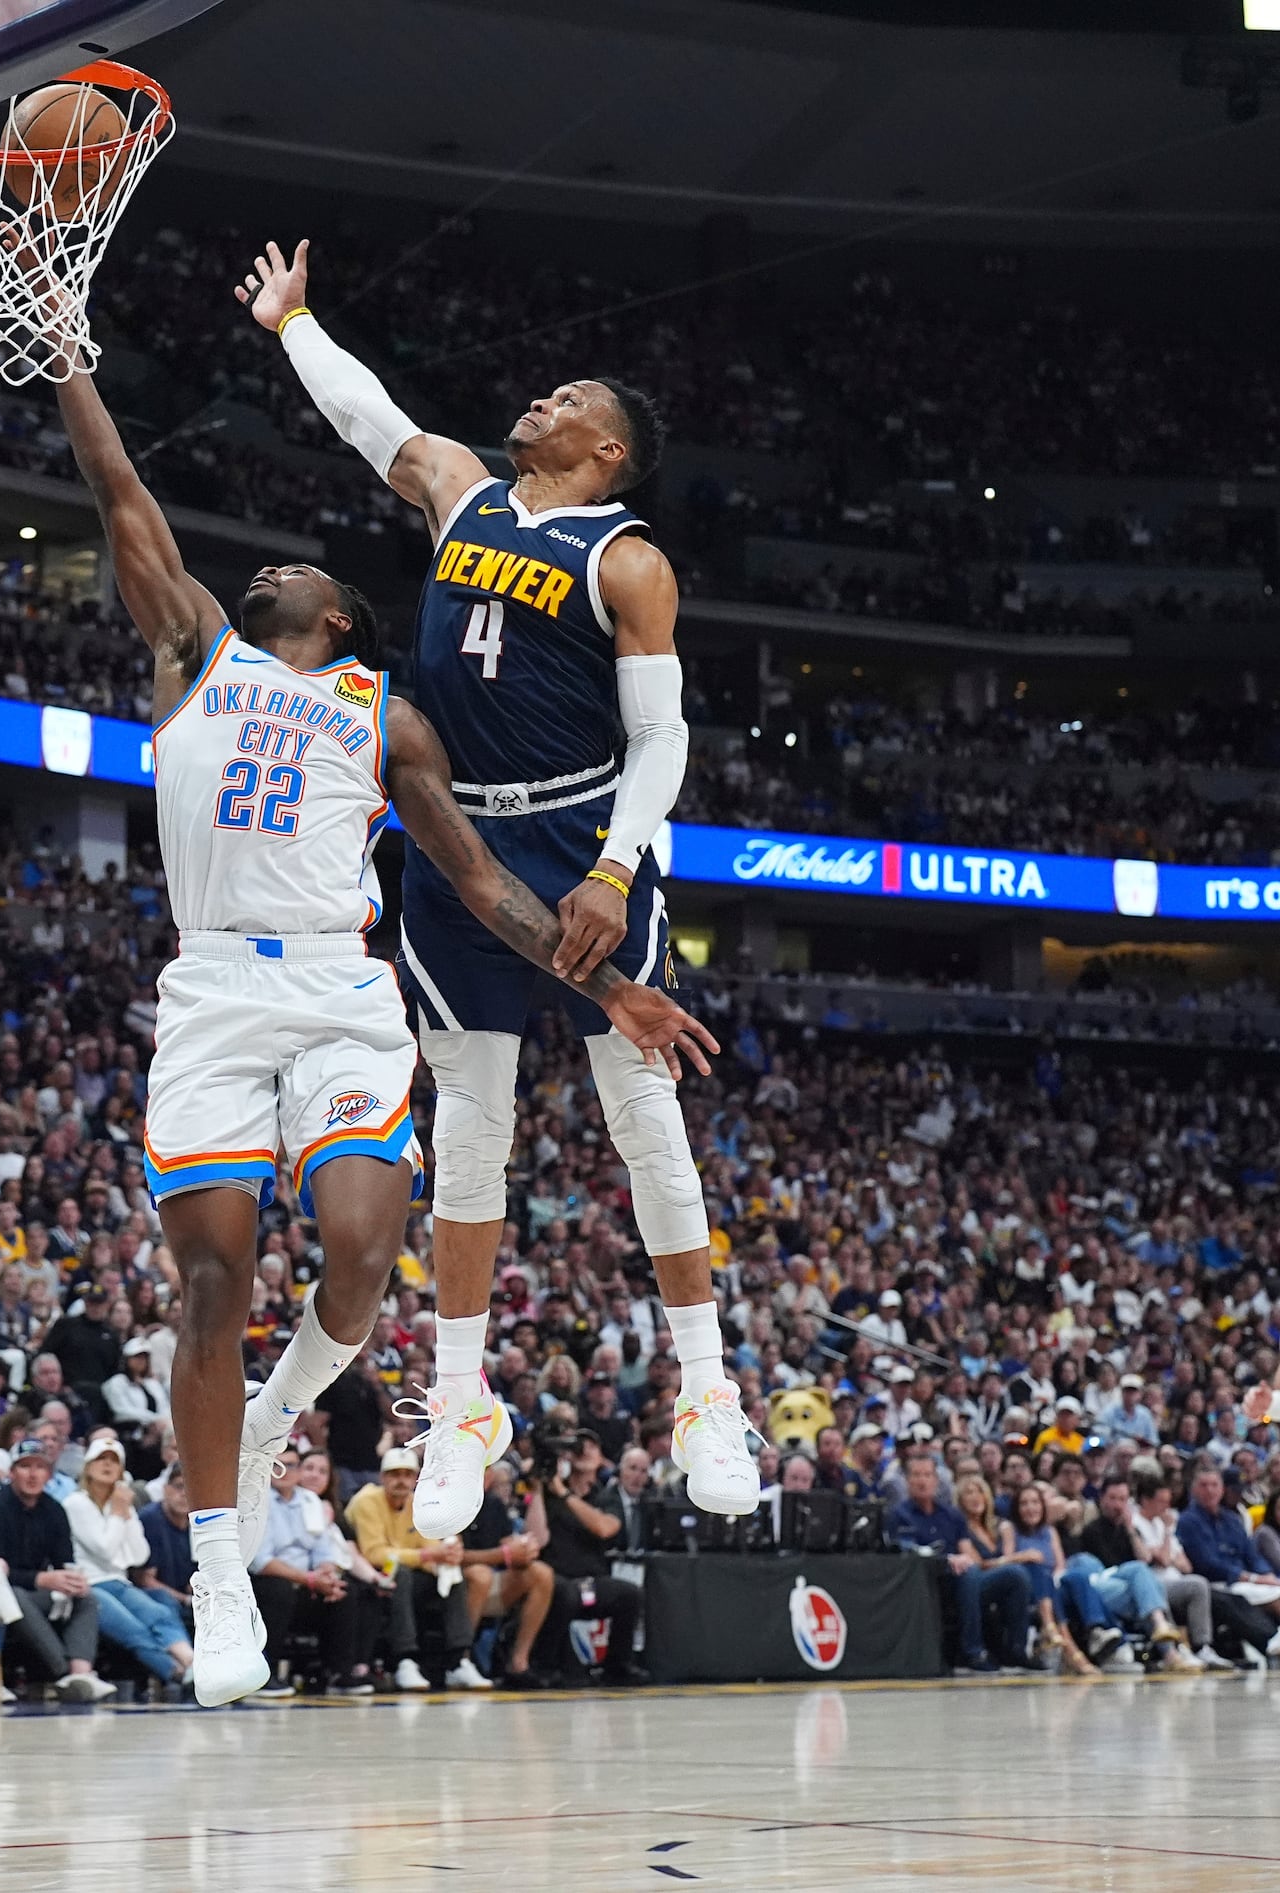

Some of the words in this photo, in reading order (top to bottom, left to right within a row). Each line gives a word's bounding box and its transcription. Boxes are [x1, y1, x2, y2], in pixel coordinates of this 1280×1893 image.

[546, 527, 587, 550] ibotta
[435, 540, 575, 619] DENVER
[460, 600, 504, 680] 4
[203, 682, 372, 757] OKLAHOMA
[237, 718, 314, 763] CITY
[214, 757, 306, 837] 22
[732, 839, 877, 886] Michelob
[910, 851, 1046, 900] ULTRA
[1205, 877, 1260, 910] IT'S
[332, 1096, 368, 1118] OKC
